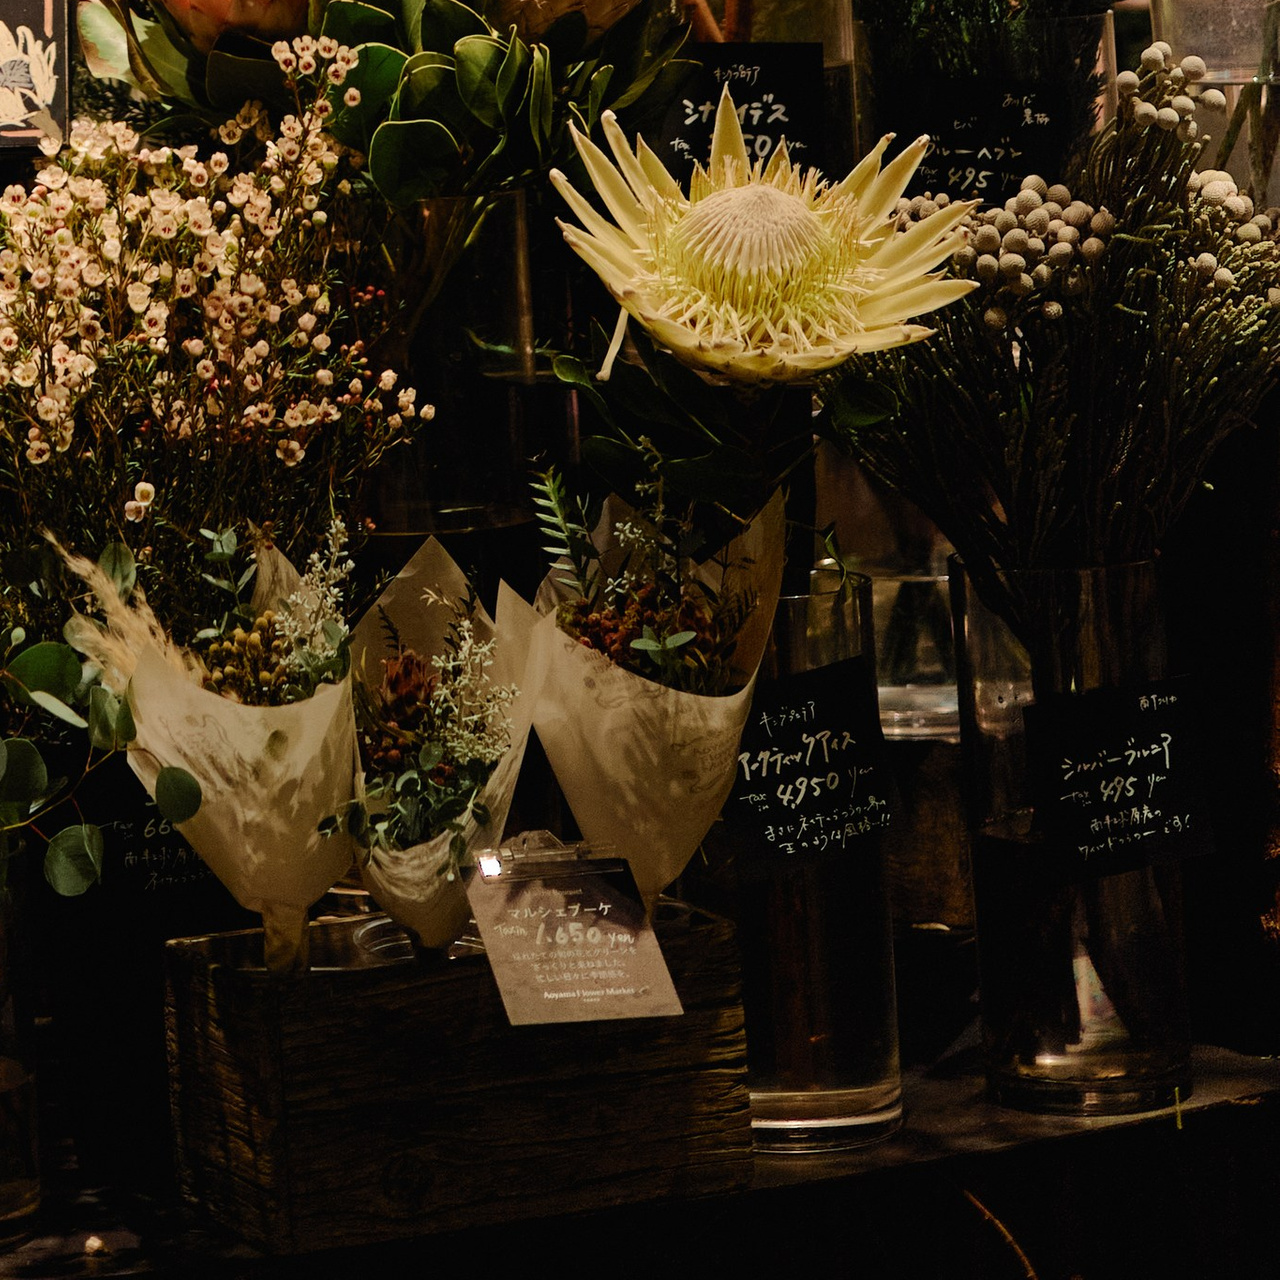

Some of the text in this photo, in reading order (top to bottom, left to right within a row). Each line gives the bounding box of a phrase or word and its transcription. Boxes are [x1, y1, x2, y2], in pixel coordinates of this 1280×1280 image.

[953, 116, 978, 130] ヒバ
[924, 135, 1023, 160] ブルーヘブン
[948, 166, 995, 191] 495
[1099, 775, 1138, 803] 495
[144, 818, 179, 838] 66
[507, 902, 612, 919] マルシェブーケ
[608, 931, 636, 948] yen
